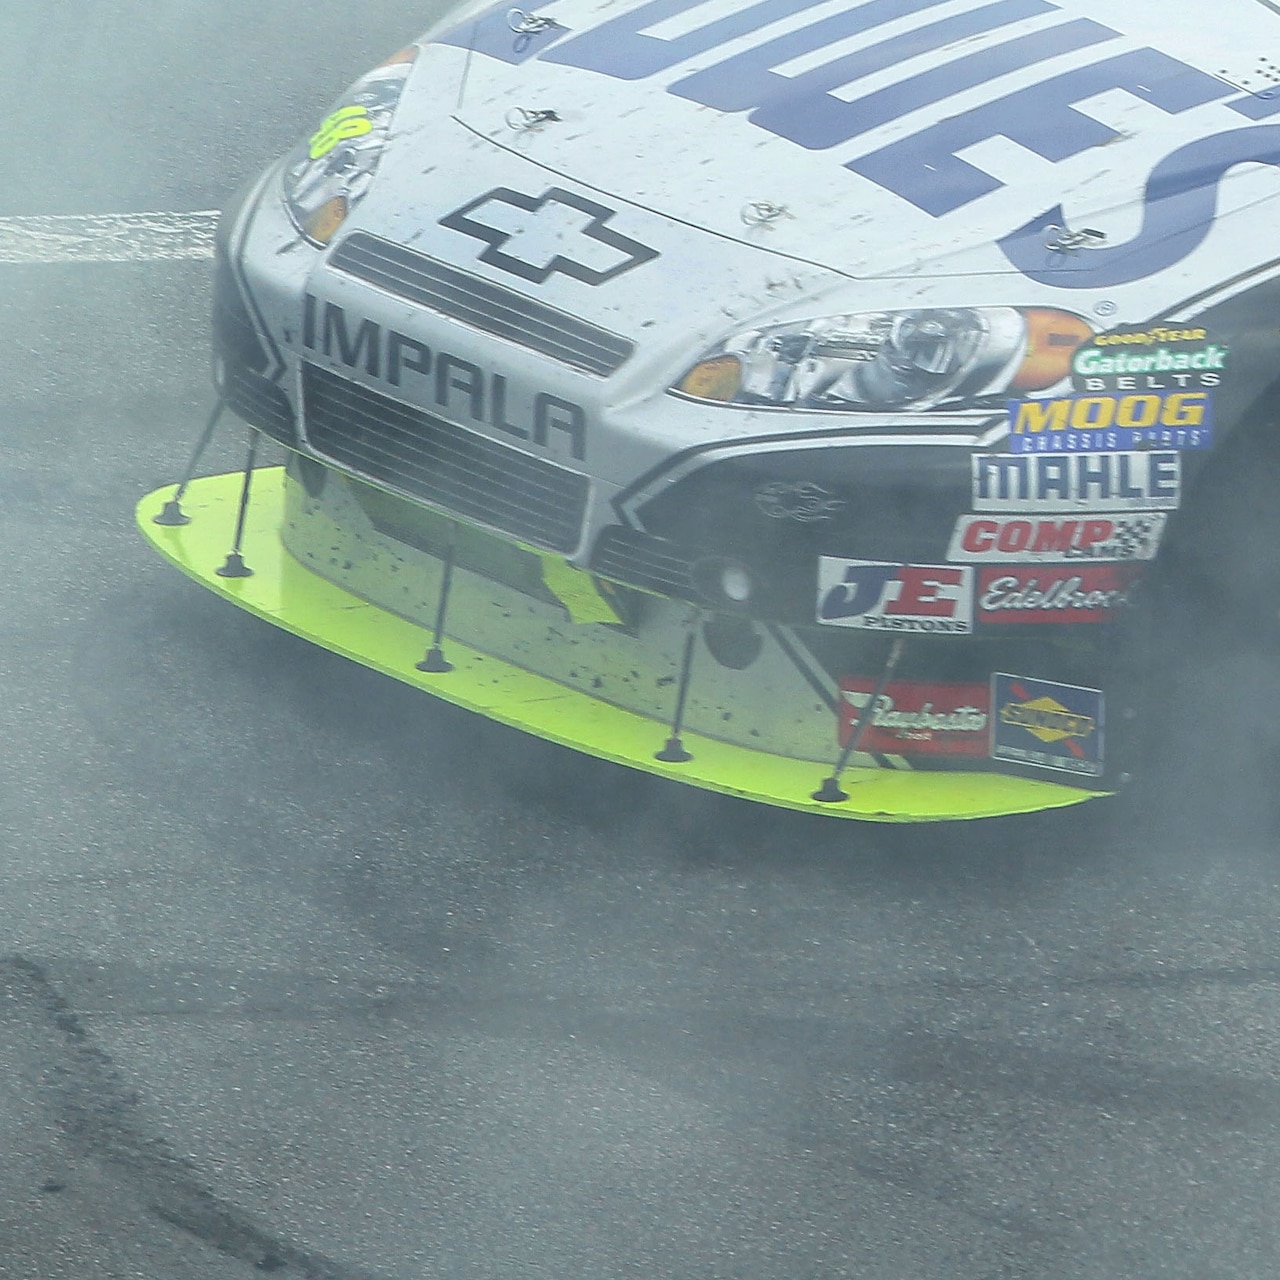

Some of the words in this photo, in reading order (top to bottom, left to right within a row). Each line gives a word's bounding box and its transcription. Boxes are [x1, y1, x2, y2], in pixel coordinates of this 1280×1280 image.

[304, 293, 588, 462] IMPALA
[1074, 346, 1226, 375] Gatorback
[1085, 372, 1222, 392] BELTS
[1015, 392, 1209, 434] MOOG
[1022, 432, 1118, 452] CHASSIS
[977, 453, 1180, 500] MAHLE
[962, 519, 1115, 554] COMP
[821, 565, 964, 621] JE
[979, 575, 1140, 612] Edelbroc
[864, 612, 969, 633] PISTONS
